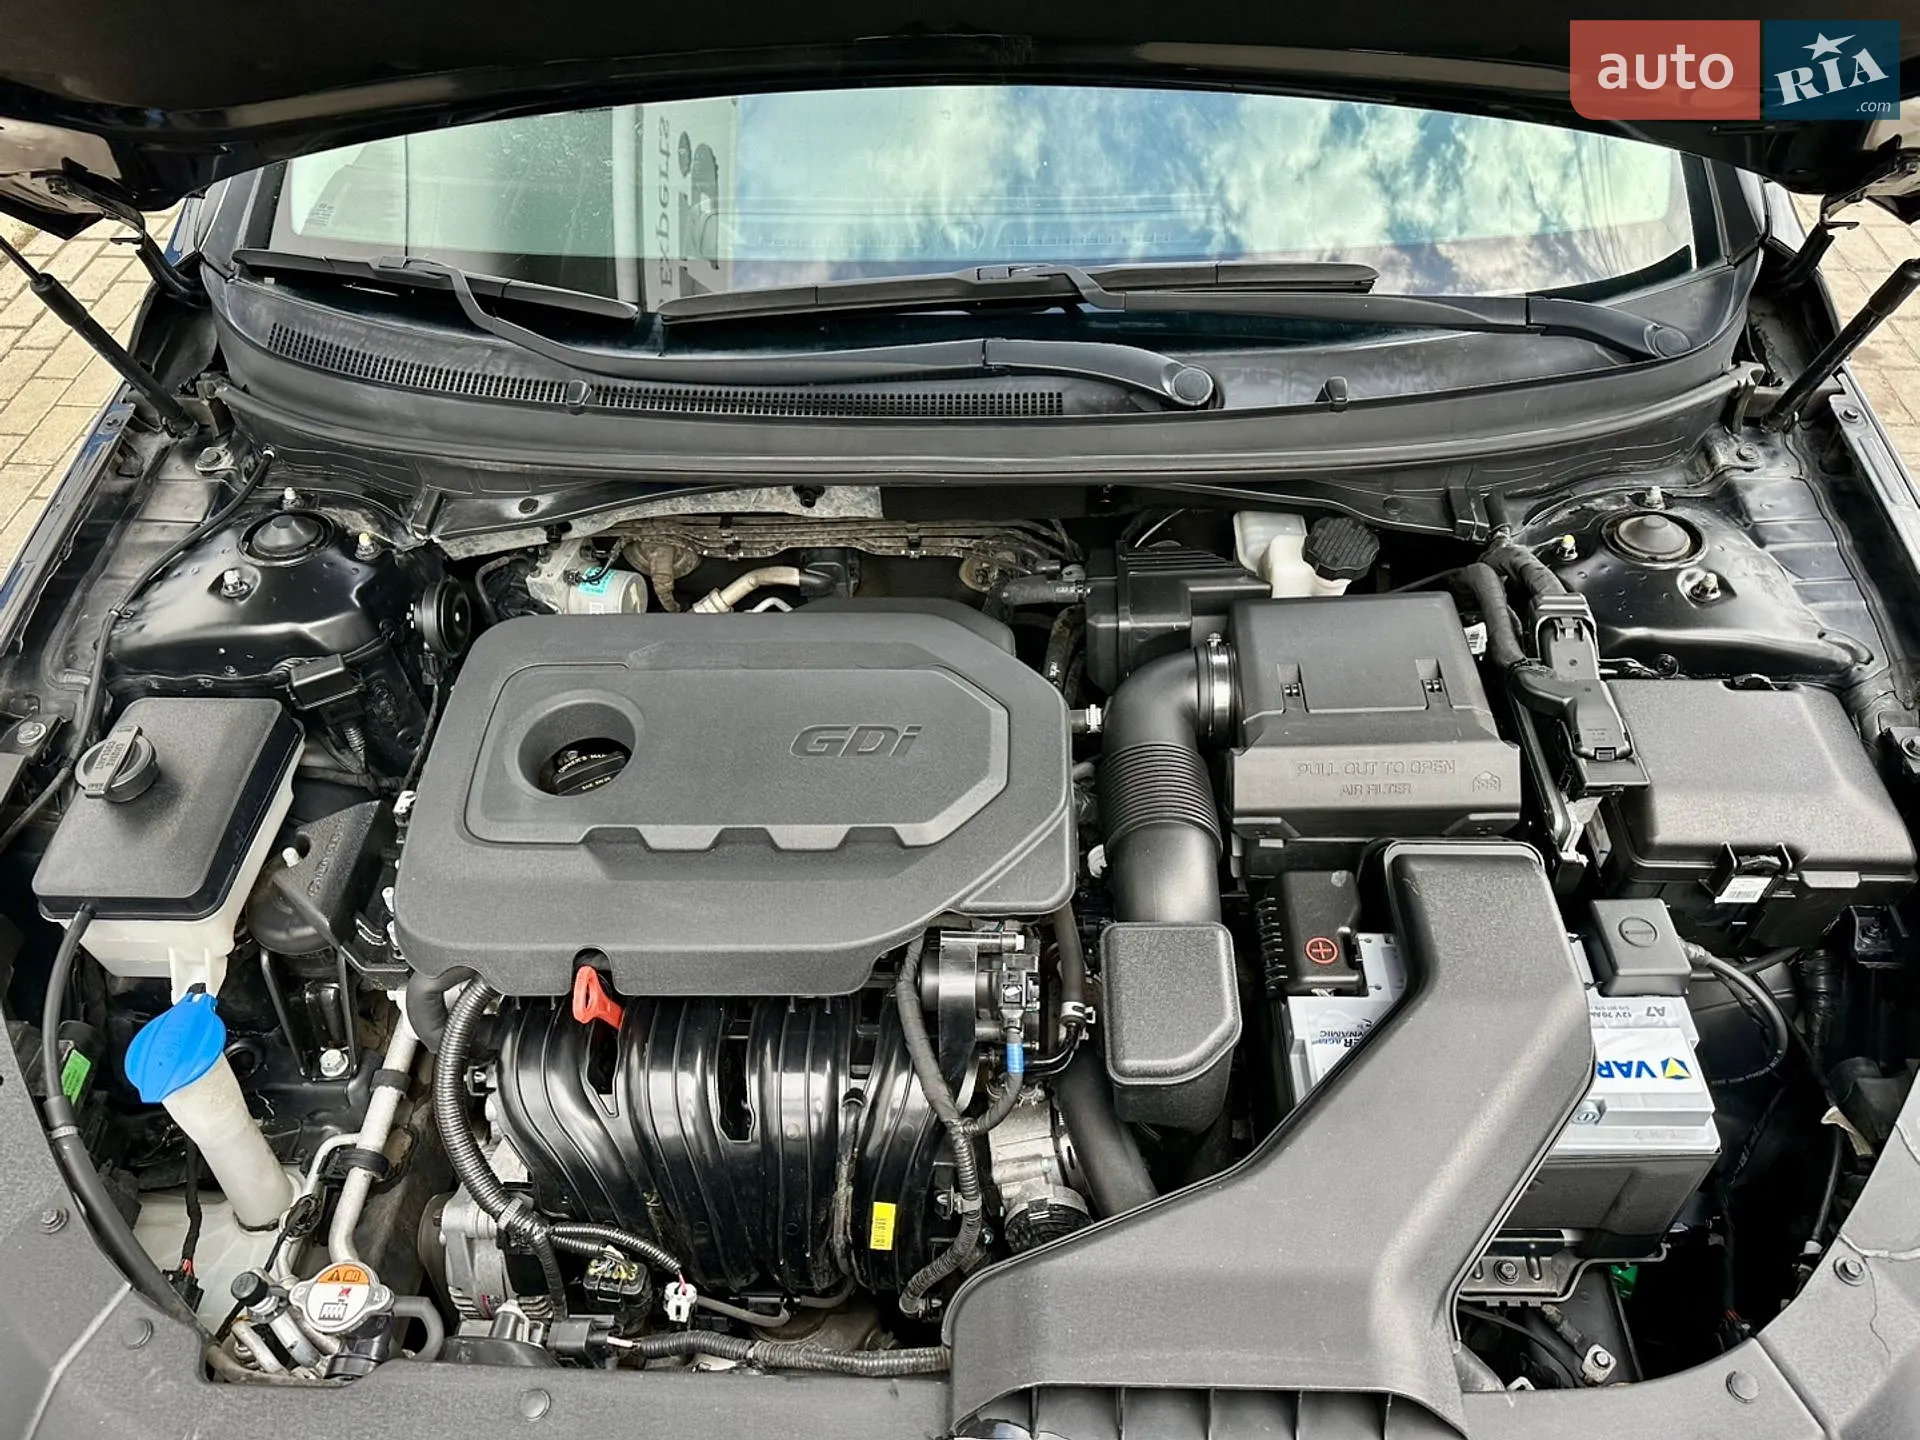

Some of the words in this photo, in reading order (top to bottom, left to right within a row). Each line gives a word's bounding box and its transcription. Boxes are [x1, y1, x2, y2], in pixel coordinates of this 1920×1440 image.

[788, 723, 923, 759] GDi
[1297, 761, 1339, 777] PULL
[1344, 761, 1379, 776] OUT
[1384, 760, 1405, 776] TO
[1410, 759, 1456, 775] OPEN
[1342, 783, 1363, 796] AIR
[1367, 782, 1413, 796] FILTER
[1646, 1006, 1667, 1017] A7
